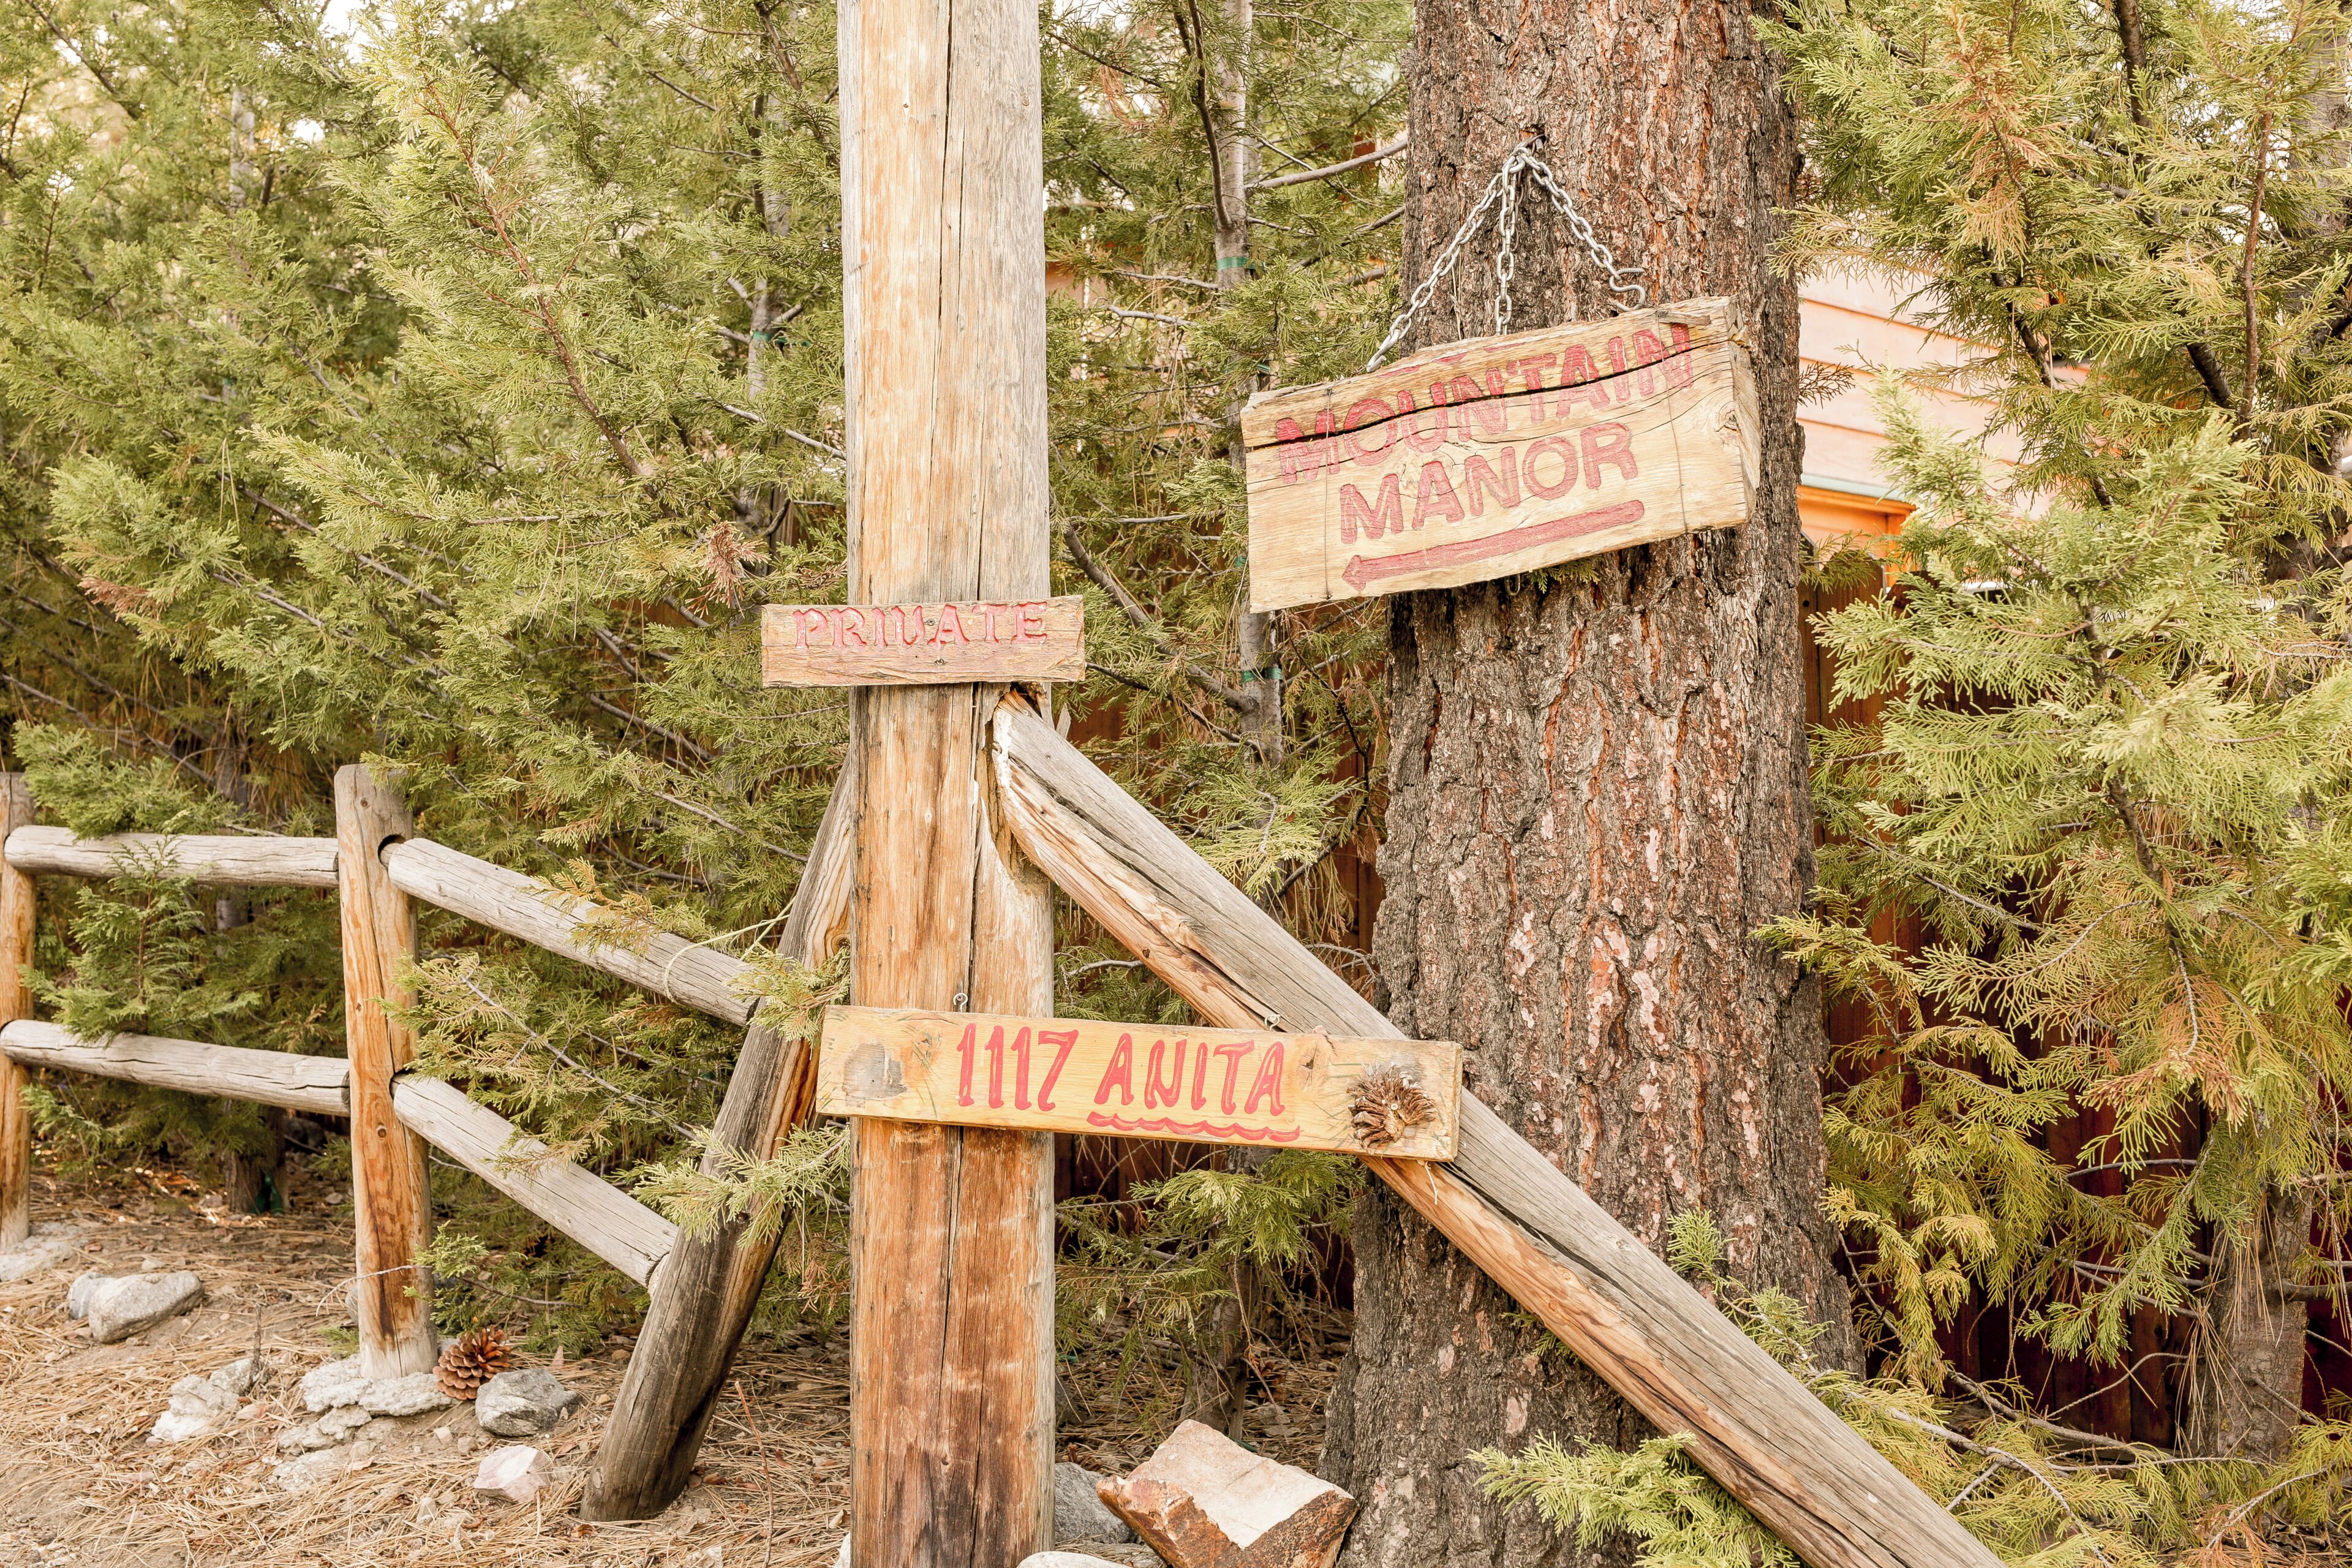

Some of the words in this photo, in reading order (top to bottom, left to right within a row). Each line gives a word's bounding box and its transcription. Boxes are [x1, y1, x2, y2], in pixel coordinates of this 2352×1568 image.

[1276, 323, 1694, 484] MOUNTAIN
[1340, 422, 1638, 545] MANOR
[792, 601, 1049, 650] PRIVATE
[957, 1022, 1080, 1112] 1117
[1094, 1032, 1286, 1116] ANITA
